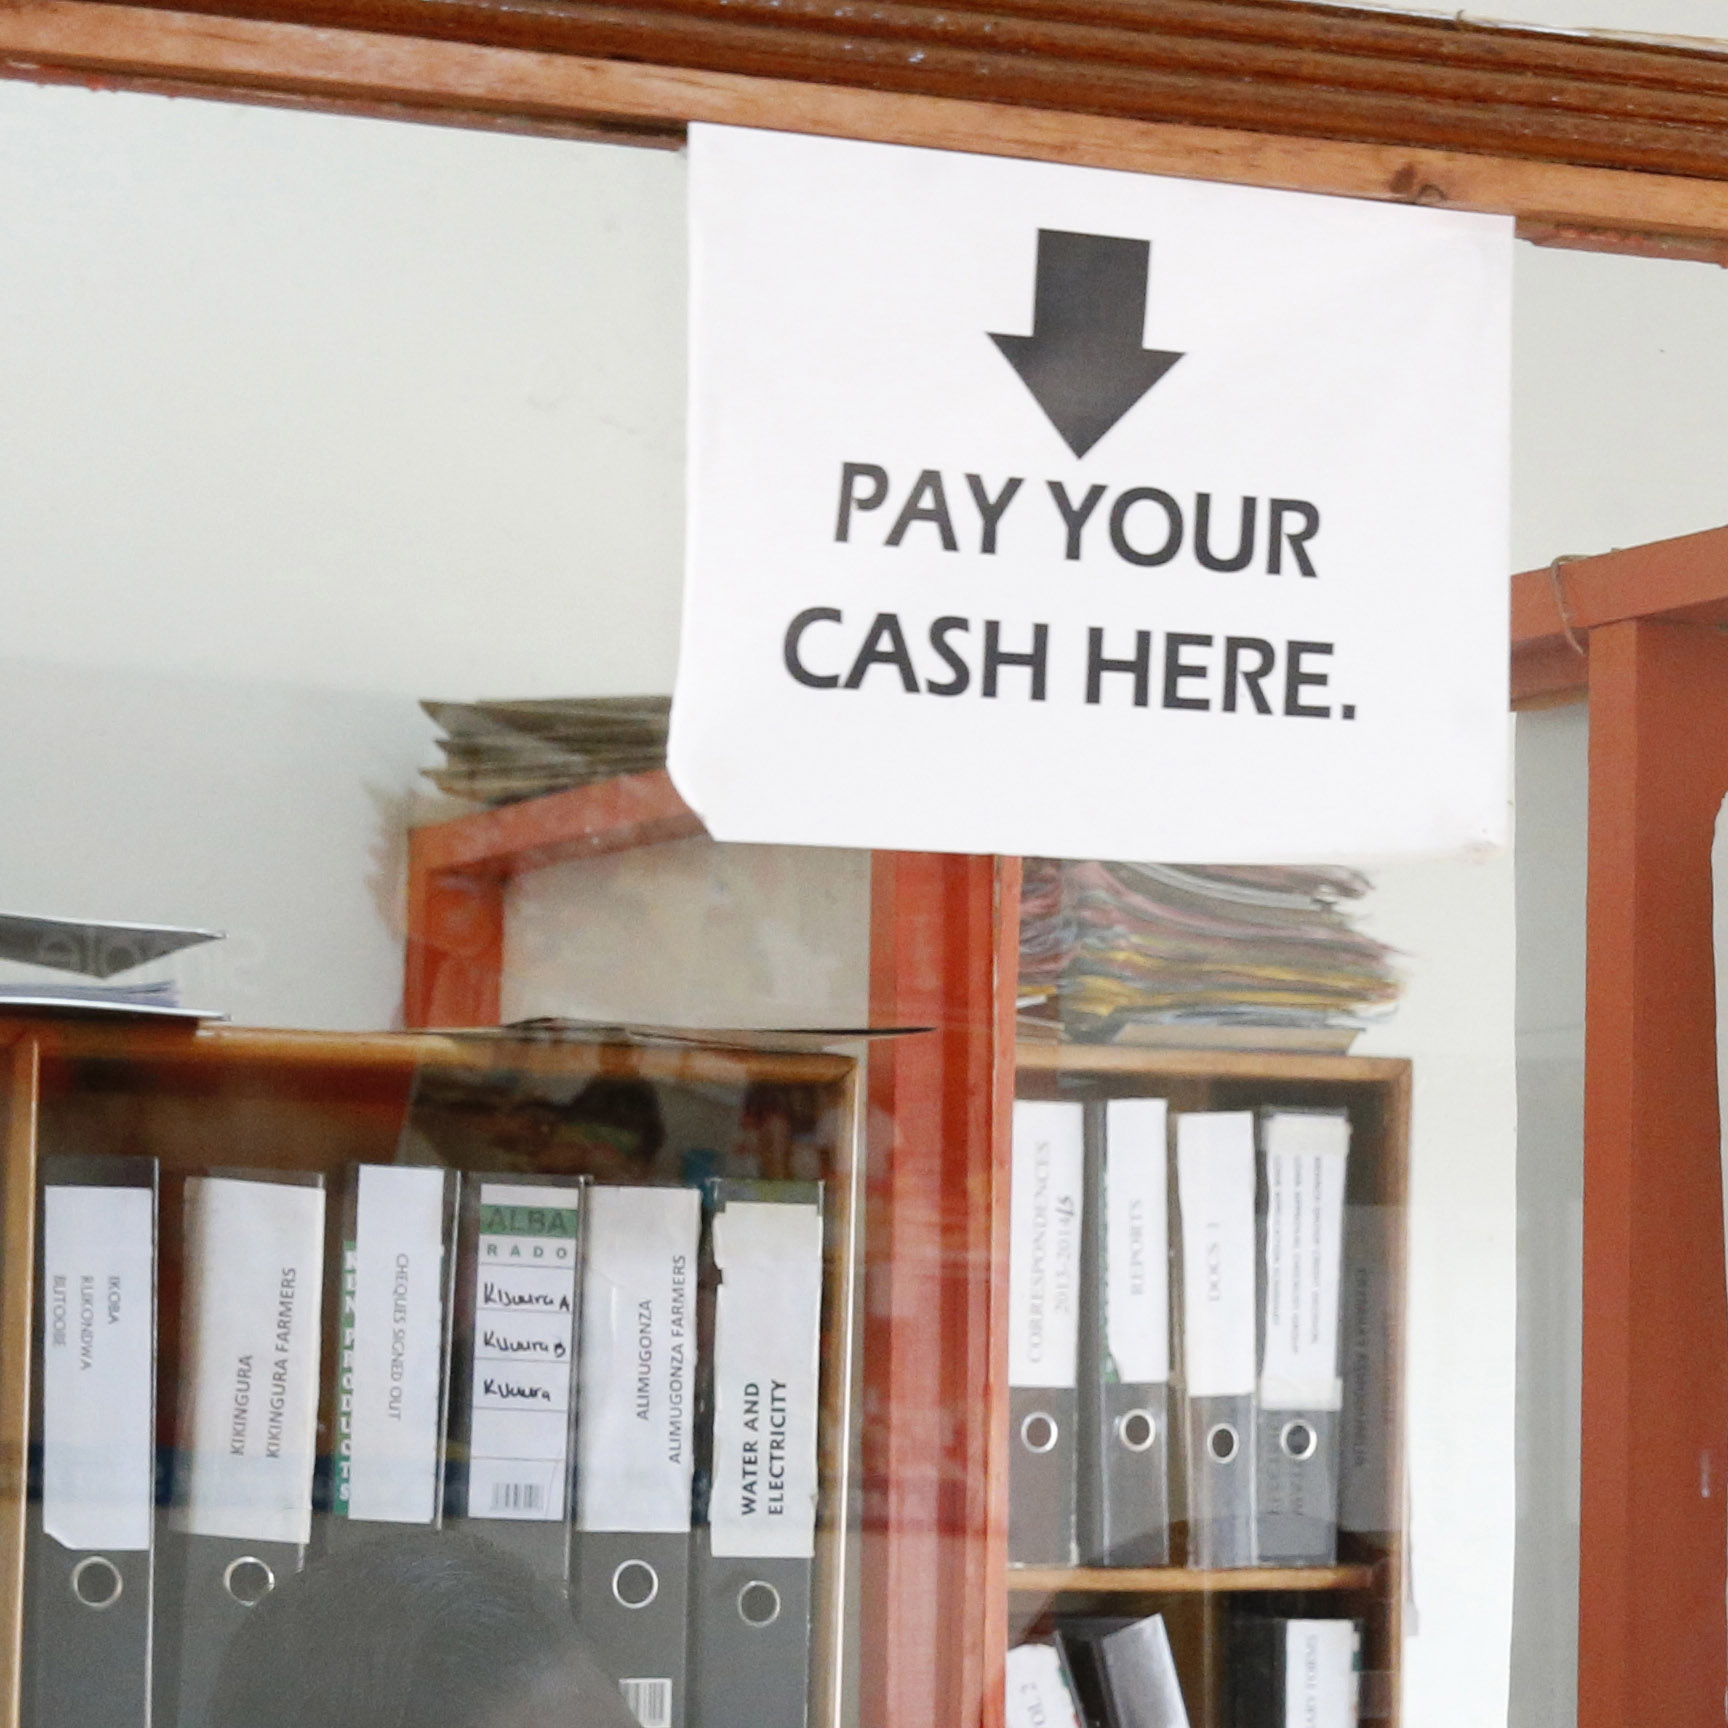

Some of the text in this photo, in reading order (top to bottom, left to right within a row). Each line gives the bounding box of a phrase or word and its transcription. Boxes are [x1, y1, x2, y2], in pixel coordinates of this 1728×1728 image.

[834, 461, 1322, 578] PAY YOUR
[782, 606, 1358, 722] CASH HERE.
[108, 1275, 122, 1325] IKOBA
[486, 1244, 569, 1261] RADO
[558, 1295, 571, 1312] A
[1026, 1140, 1050, 1363] CORRESPONDENCES
[1130, 1198, 1144, 1295] REPORTS
[266, 1266, 298, 1459] KIKINGURA FARMERS
[388, 1253, 410, 1421] CHEQUES SIGNED OUT
[636, 1300, 653, 1421] ALIMUGONZA
[669, 1254, 687, 1465] ALIMUGONZA FARMERS
[230, 1354, 253, 1457] KIKINGURA
[741, 1382, 761, 1516] WATER AND
[768, 1378, 789, 1516] ELECTRICITY
